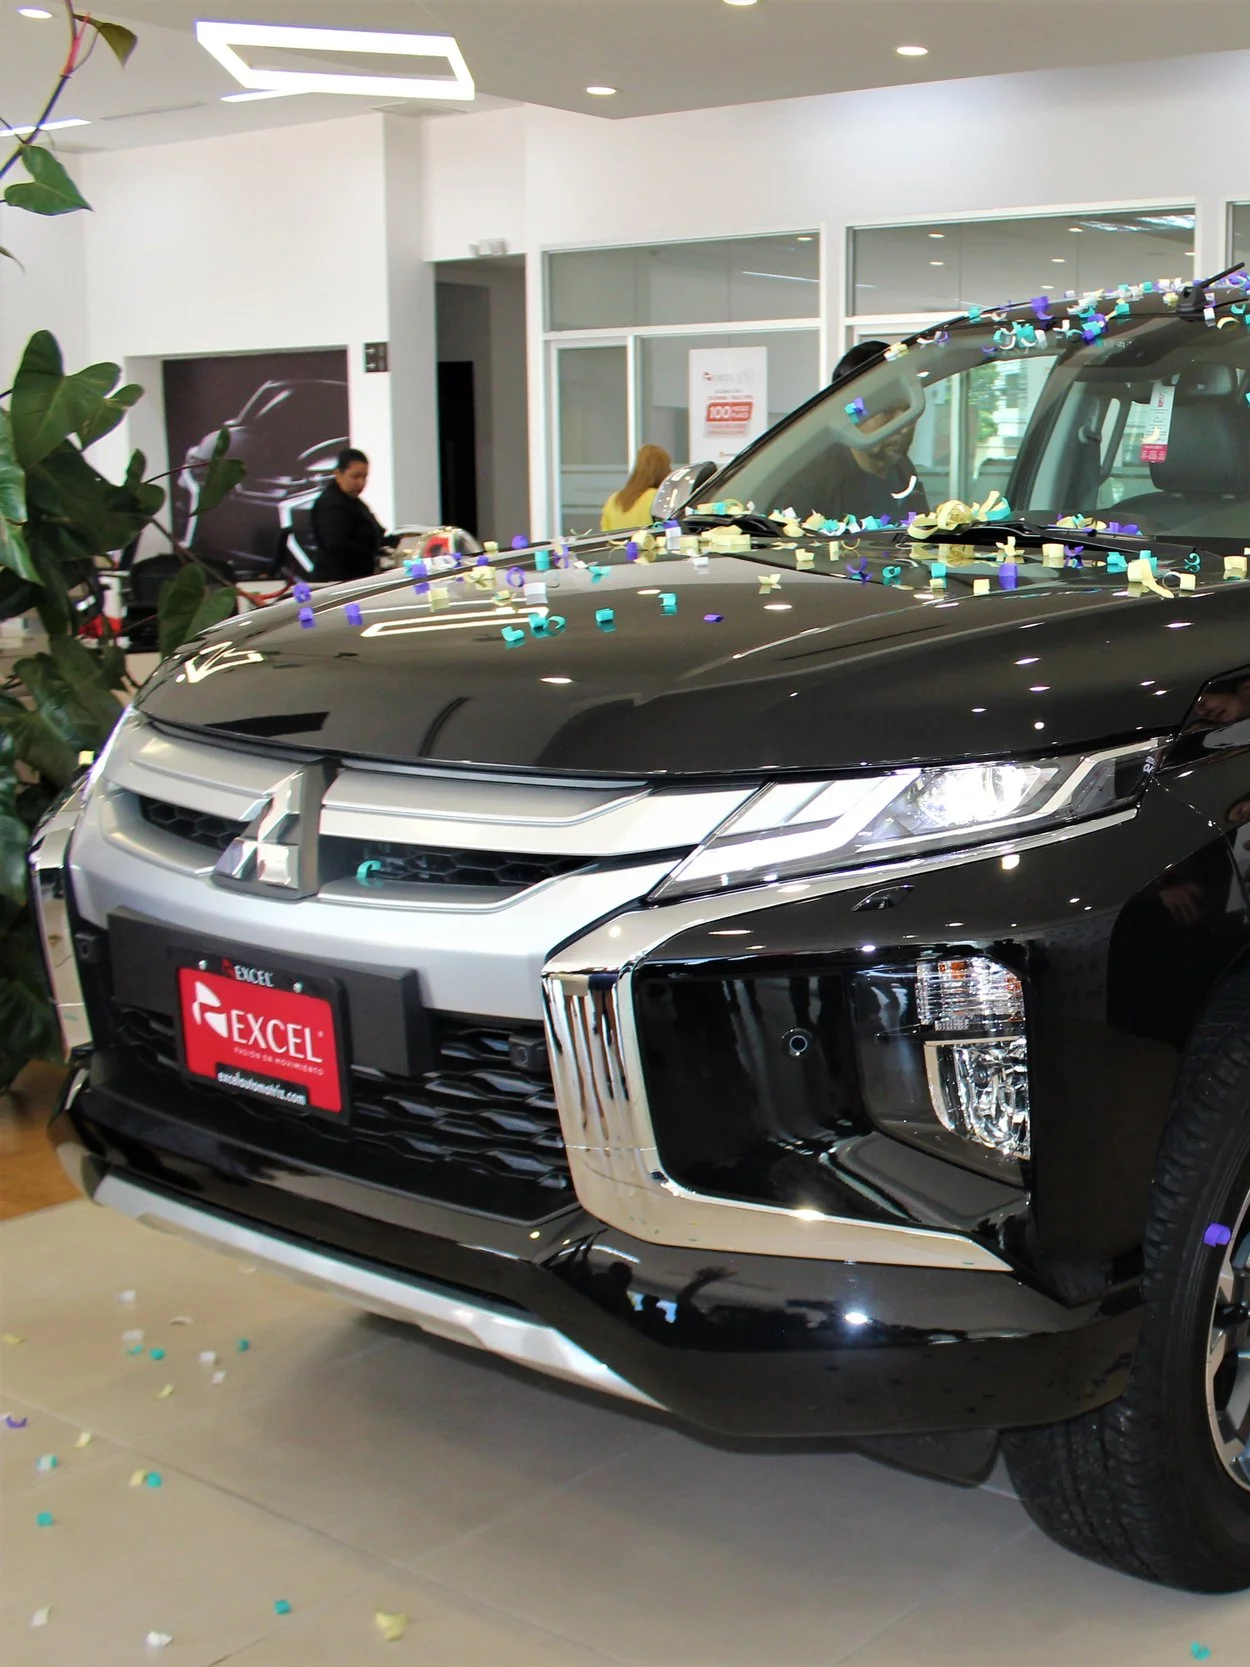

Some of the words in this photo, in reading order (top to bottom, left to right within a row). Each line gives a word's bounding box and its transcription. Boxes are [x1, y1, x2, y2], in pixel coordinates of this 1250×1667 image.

[709, 405, 730, 419] 100
[234, 965, 274, 988] EXCEL
[231, 1009, 323, 1064] EXCEL
